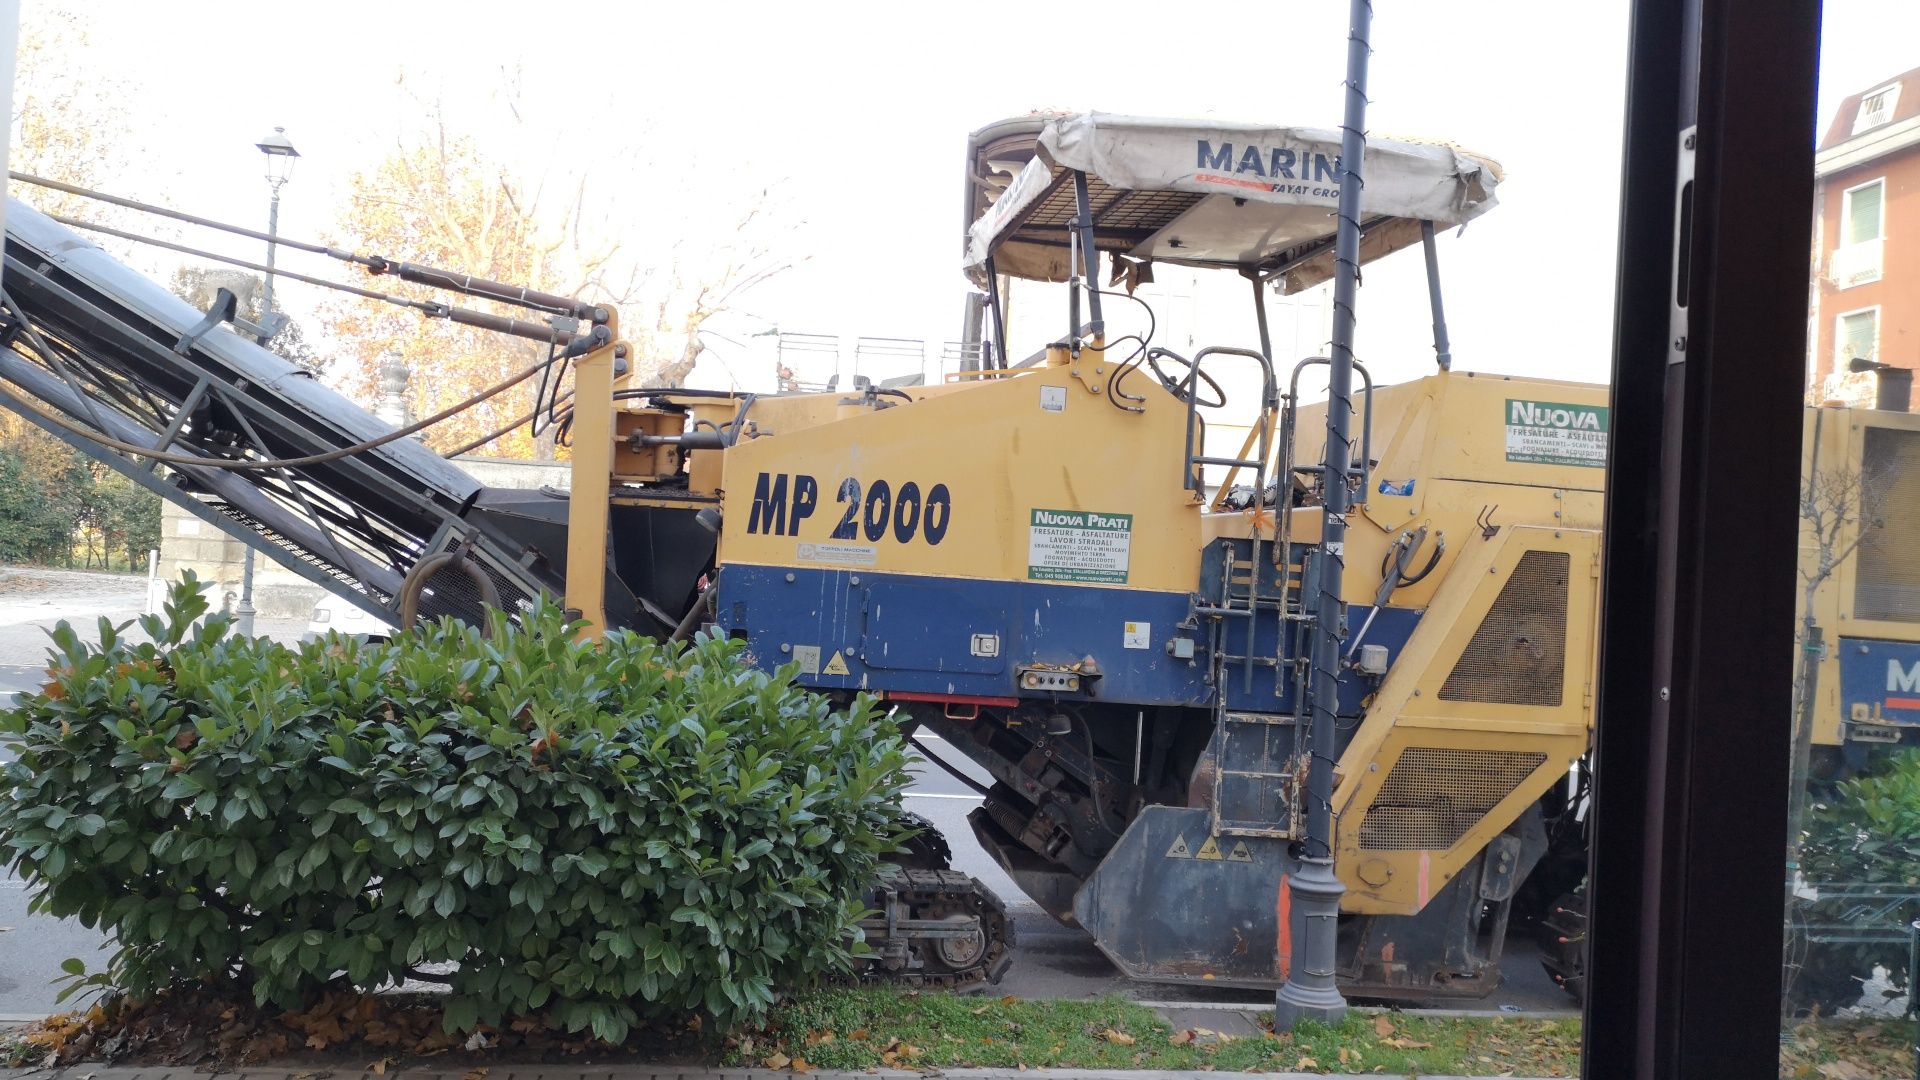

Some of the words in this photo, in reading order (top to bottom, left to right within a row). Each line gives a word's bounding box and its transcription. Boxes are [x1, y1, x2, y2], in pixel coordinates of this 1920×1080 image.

[1272, 183, 1309, 195] FAYAT
[1512, 401, 1600, 430] NUOVA
[1513, 428, 1559, 439] FRESATURE
[747, 472, 817, 536] MP
[830, 476, 951, 546] 2000
[1035, 511, 1084, 526] NUOVA
[1087, 514, 1128, 529] PRATI
[1034, 528, 1074, 537] FRESATURE
[1081, 531, 1129, 540] ASFALTATURE
[1078, 538, 1112, 546] STRADALI
